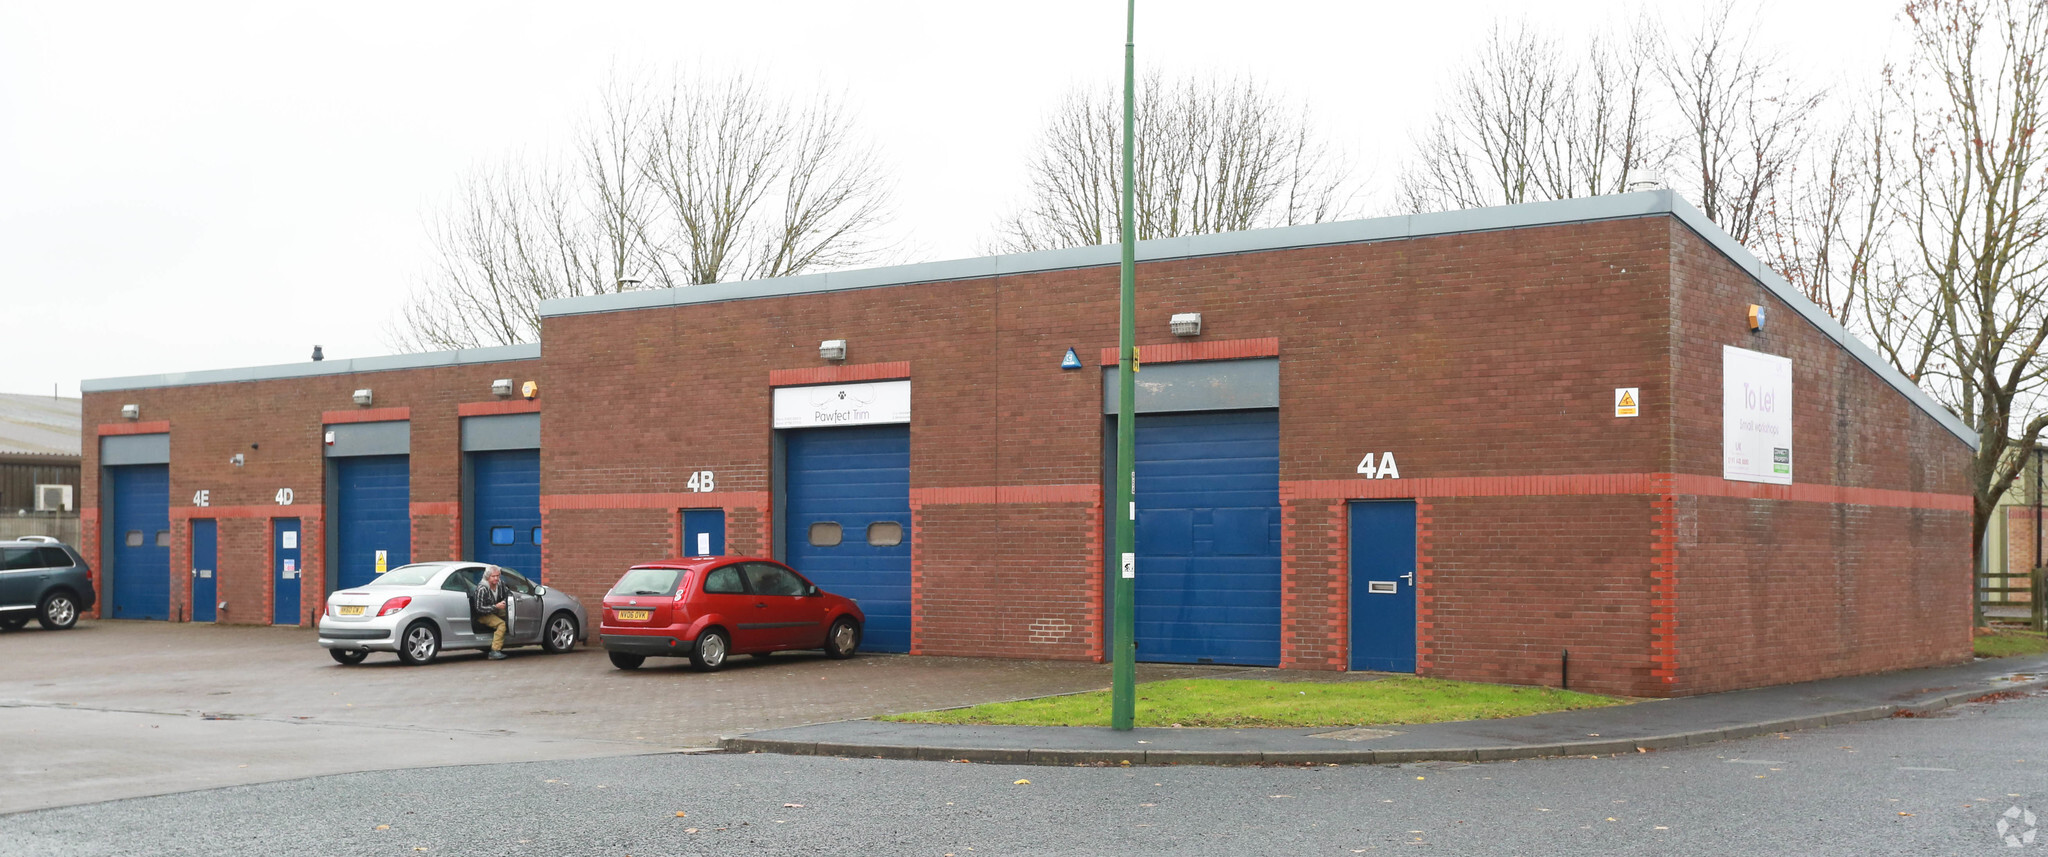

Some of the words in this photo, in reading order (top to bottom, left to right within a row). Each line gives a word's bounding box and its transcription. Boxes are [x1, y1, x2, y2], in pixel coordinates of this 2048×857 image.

[1743, 382, 1756, 411] To
[1759, 385, 1776, 413] Let
[815, 409, 850, 423] Pawfect
[853, 409, 870, 420] Trim
[1357, 451, 1400, 479] 4A
[687, 470, 715, 493] 4B
[193, 490, 210, 507] 4E
[275, 488, 294, 506] 4D
